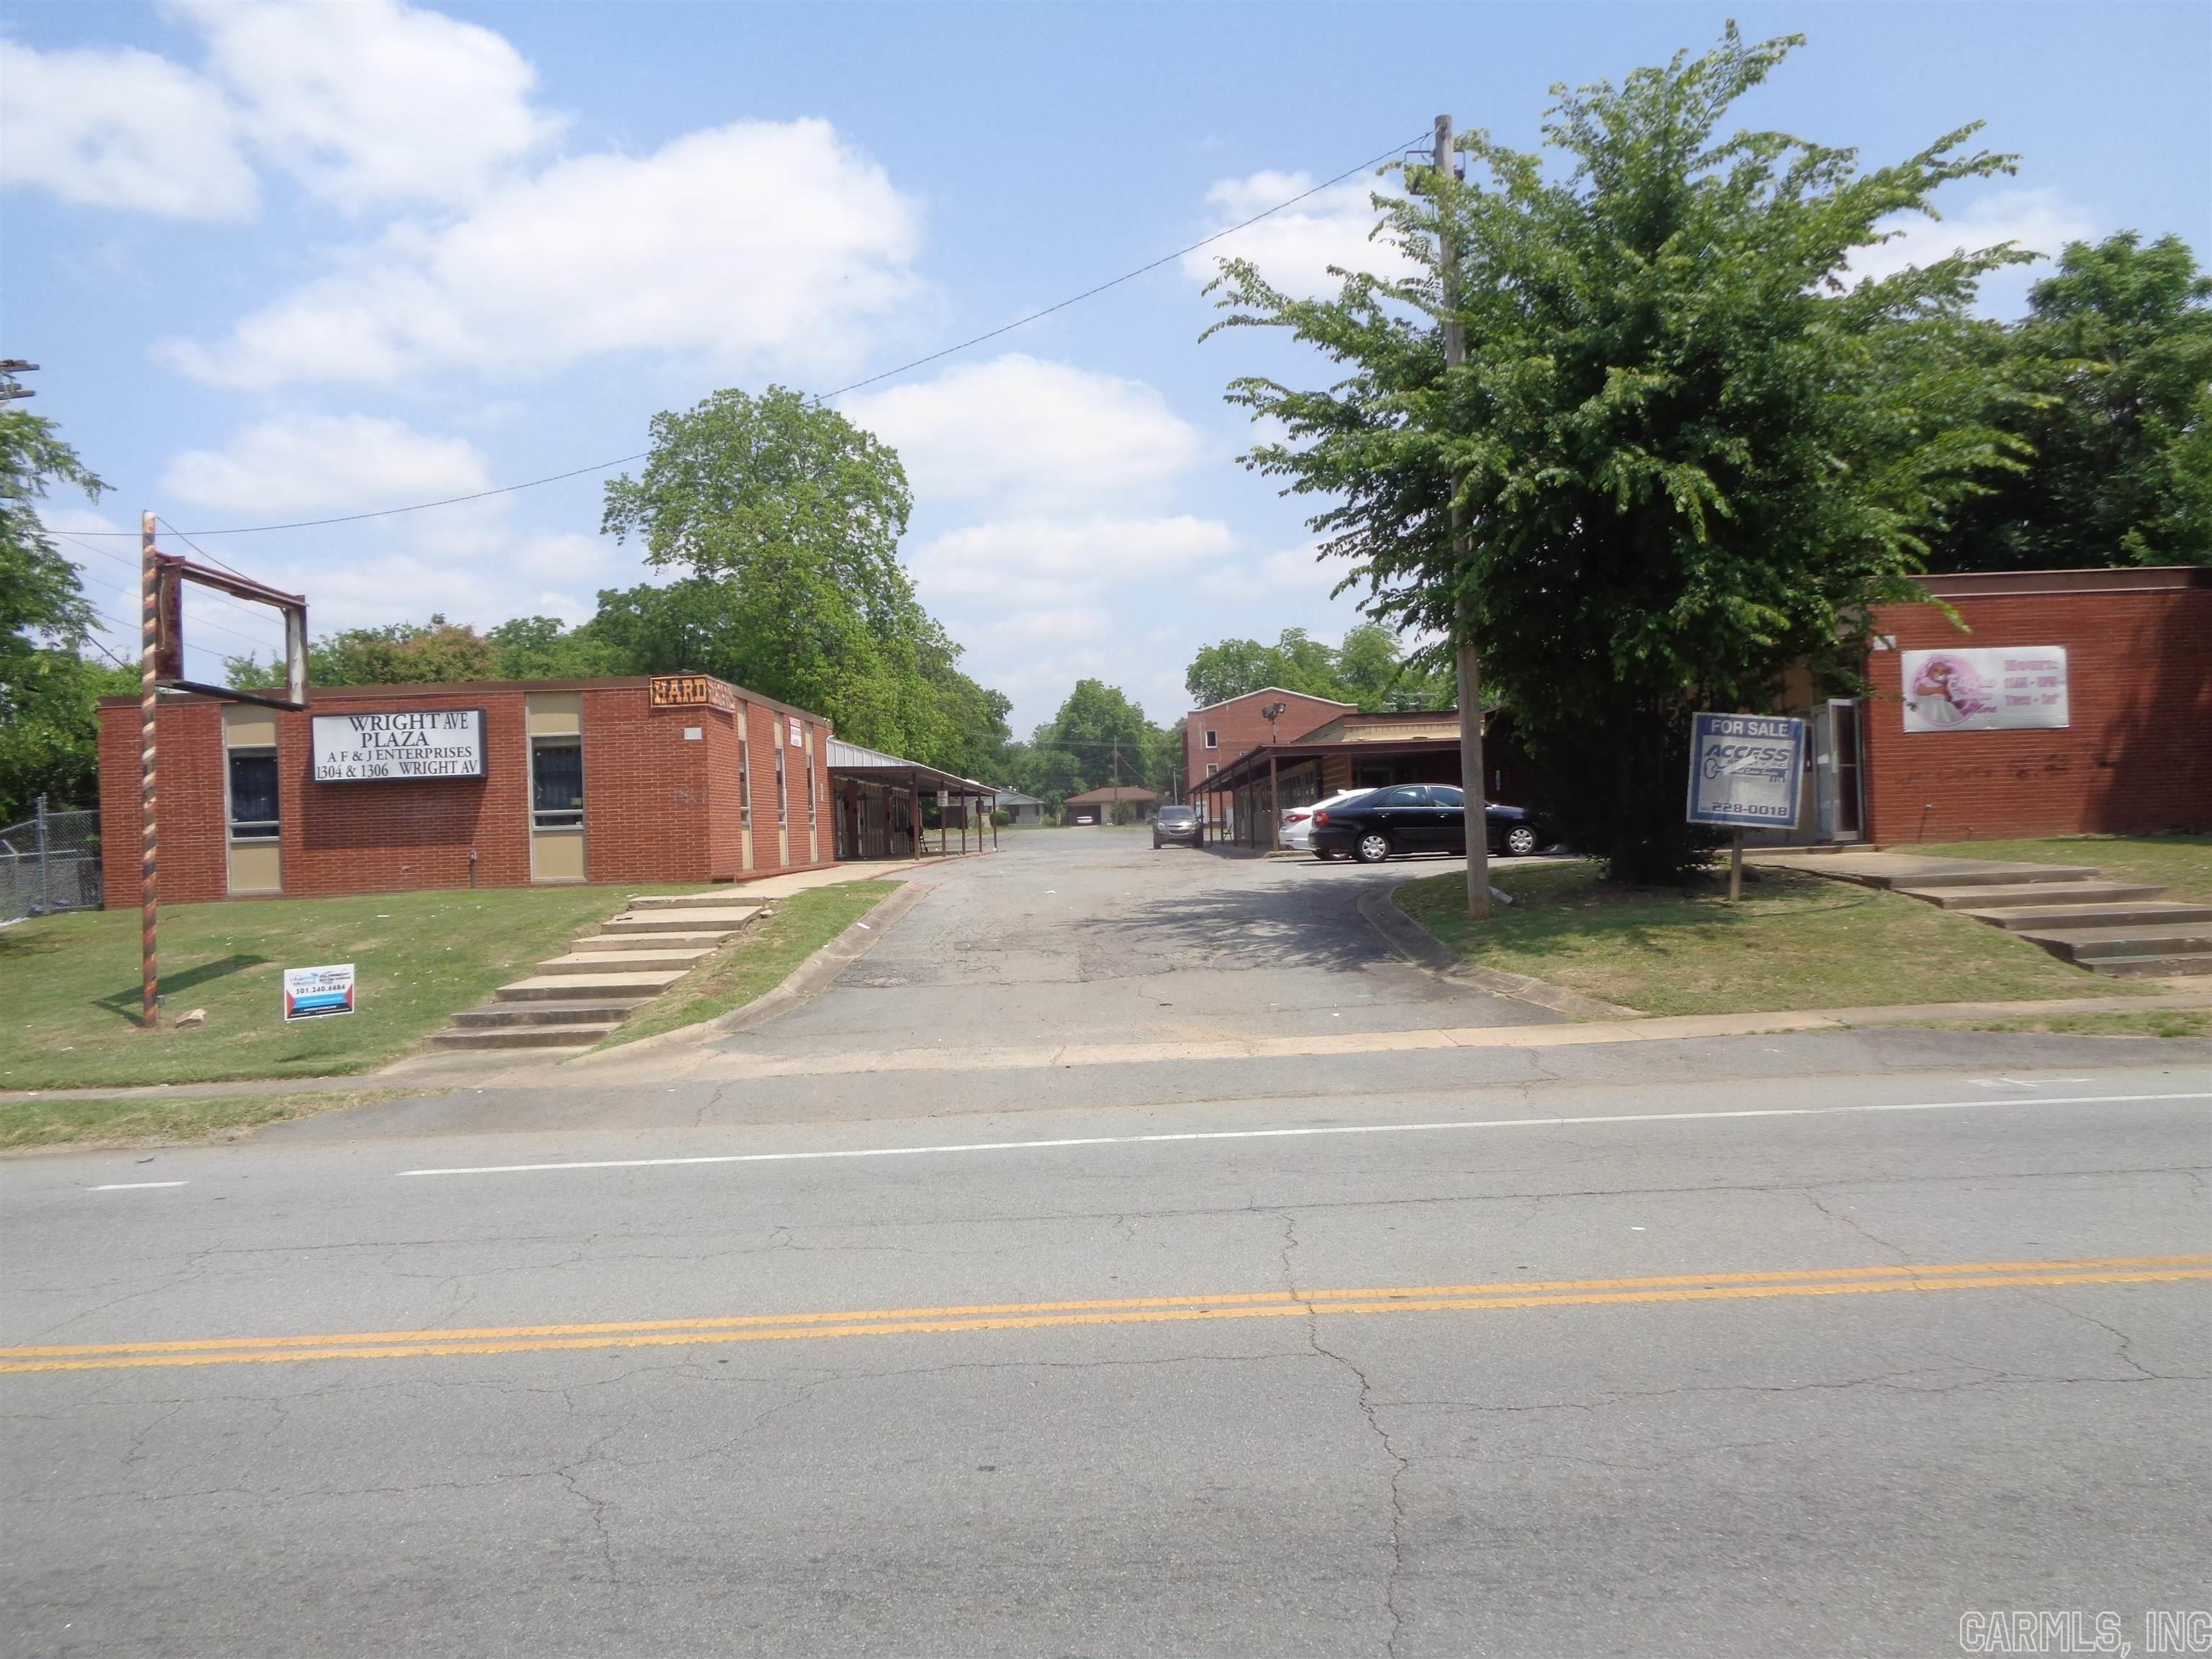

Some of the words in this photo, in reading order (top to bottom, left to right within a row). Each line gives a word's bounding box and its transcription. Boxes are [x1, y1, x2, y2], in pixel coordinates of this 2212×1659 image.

[655, 679, 706, 703] HARD
[349, 714, 440, 732] WRIGHT
[444, 712, 468, 729] AVE
[1711, 719, 1743, 734] FOR
[1748, 721, 1789, 737] SALE
[361, 732, 429, 748] PLAZA
[328, 752, 336, 763] A
[341, 751, 348, 762] F
[352, 750, 363, 761] &
[366, 750, 372, 762] J
[377, 747, 472, 760] ENTERPRISES
[1705, 745, 1791, 762] ACCESS
[317, 764, 342, 779] 1304
[346, 765, 357, 778] &
[361, 763, 389, 778] 1306
[399, 760, 458, 775] WRIGHT
[461, 760, 478, 774] AV
[1712, 802, 1787, 816] 228-0018
